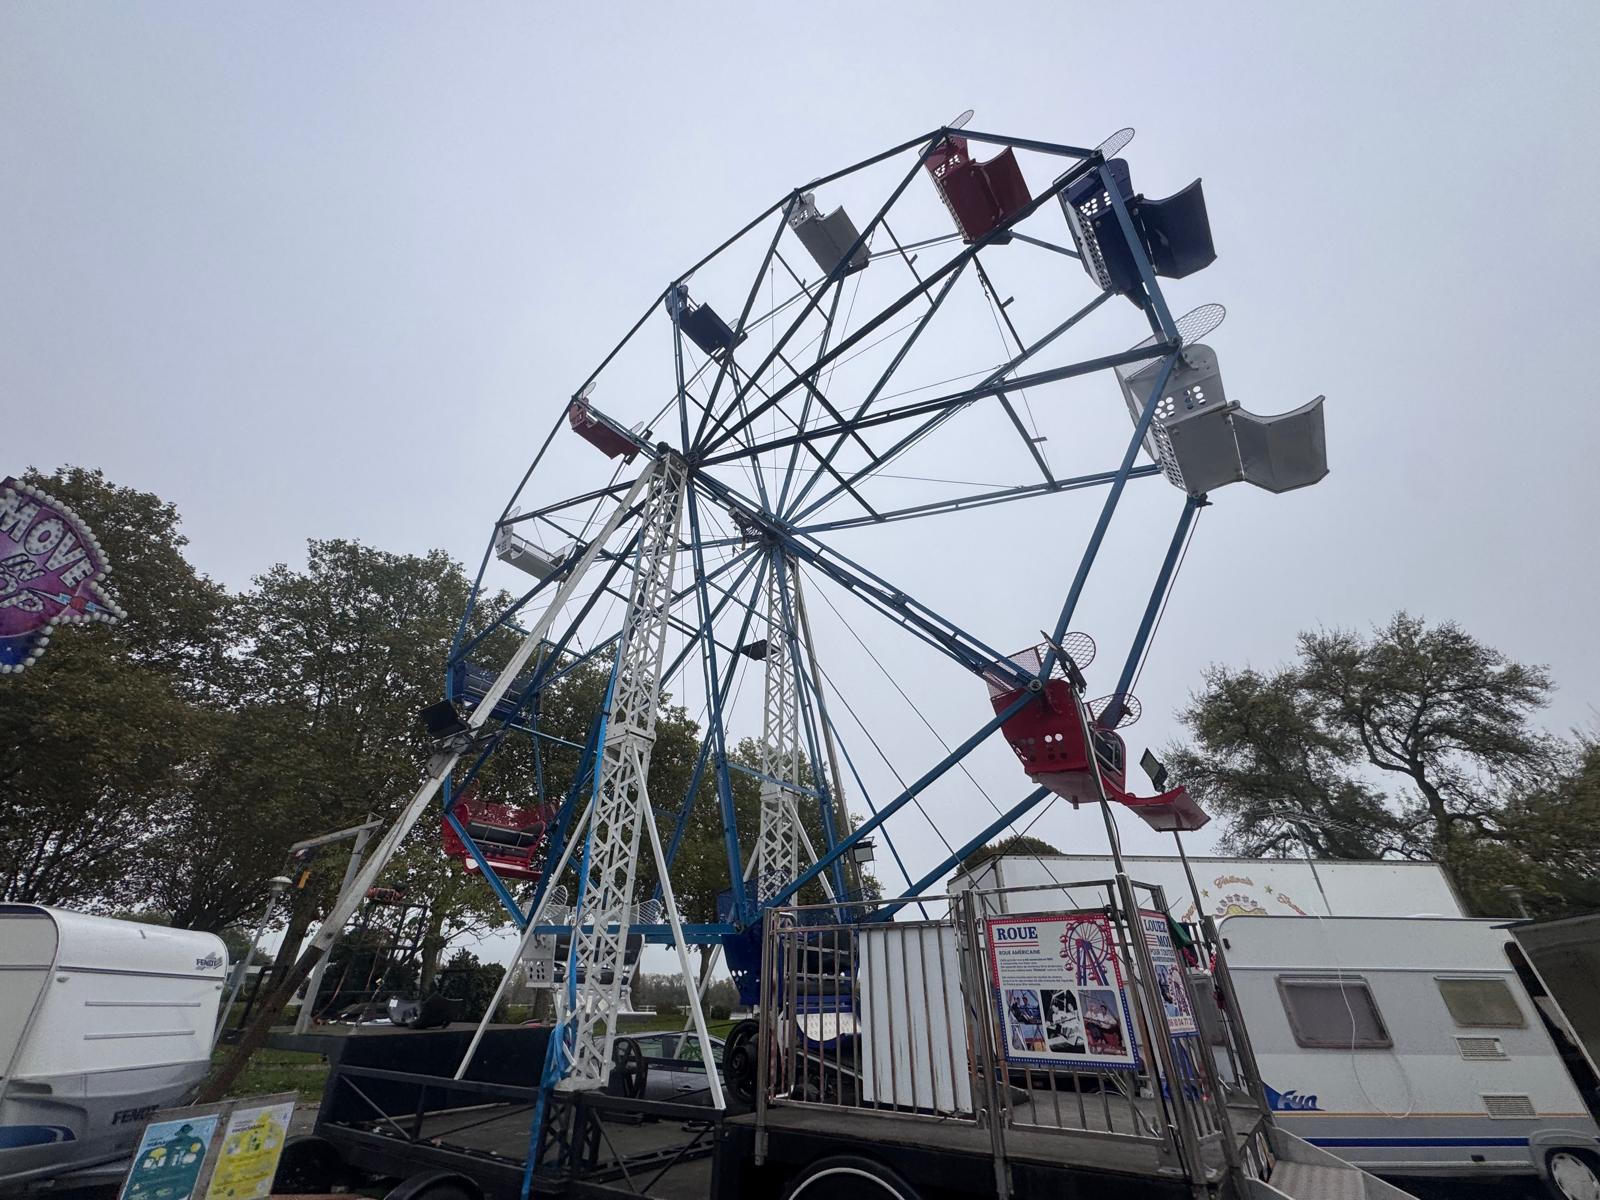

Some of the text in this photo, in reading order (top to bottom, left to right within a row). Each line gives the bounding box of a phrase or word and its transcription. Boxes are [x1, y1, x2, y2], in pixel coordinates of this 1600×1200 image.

[0, 488, 95, 588] MOVE
[996, 926, 1038, 940] ROUE
[1157, 935, 1171, 948] MOI
[196, 958, 219, 967] FENDT
[1277, 1090, 1318, 1110] Fun
